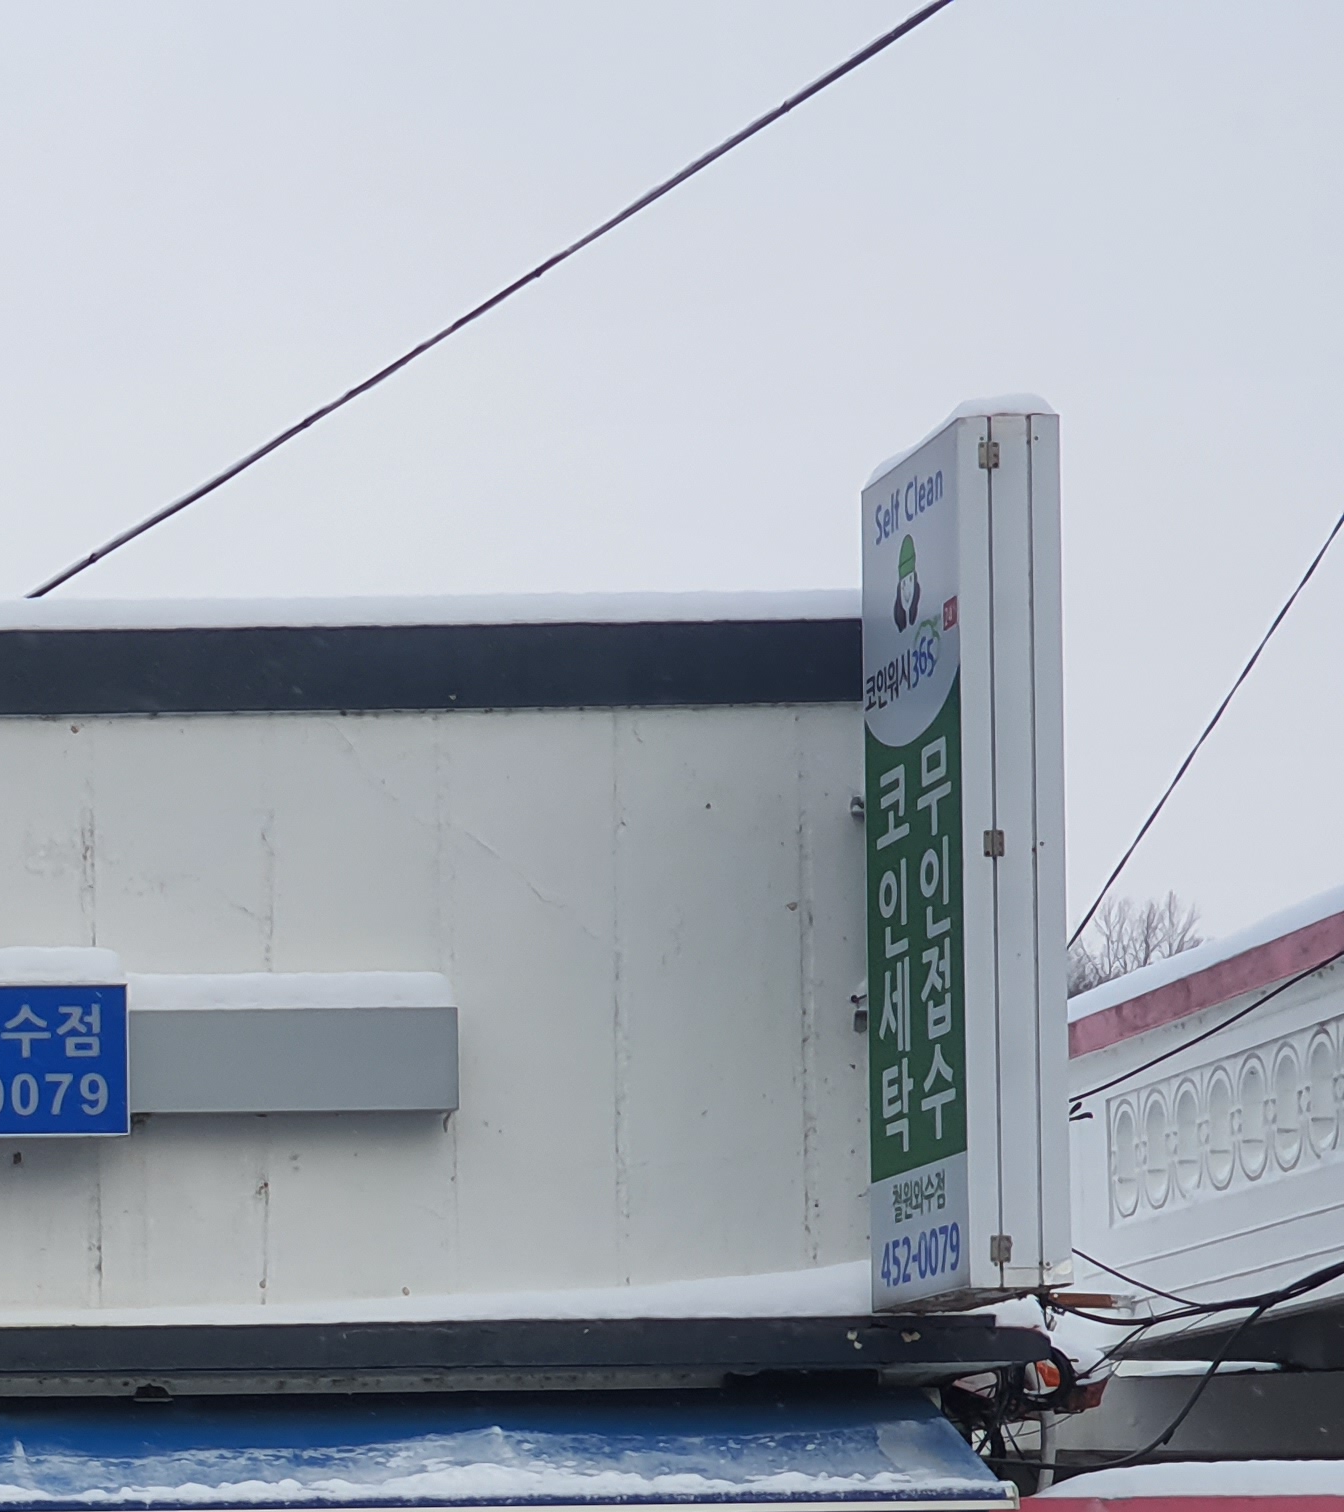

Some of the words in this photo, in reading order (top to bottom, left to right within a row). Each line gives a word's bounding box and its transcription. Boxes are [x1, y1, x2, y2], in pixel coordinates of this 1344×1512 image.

[875, 482, 900, 545] Self
[904, 469, 943, 522] Clean
[876, 763, 913, 1152] 코인세탁
[916, 735, 956, 1140] 무인접수
[892, 1169, 946, 1224] 철원와수점
[881, 1222, 960, 1287] 452-0079
